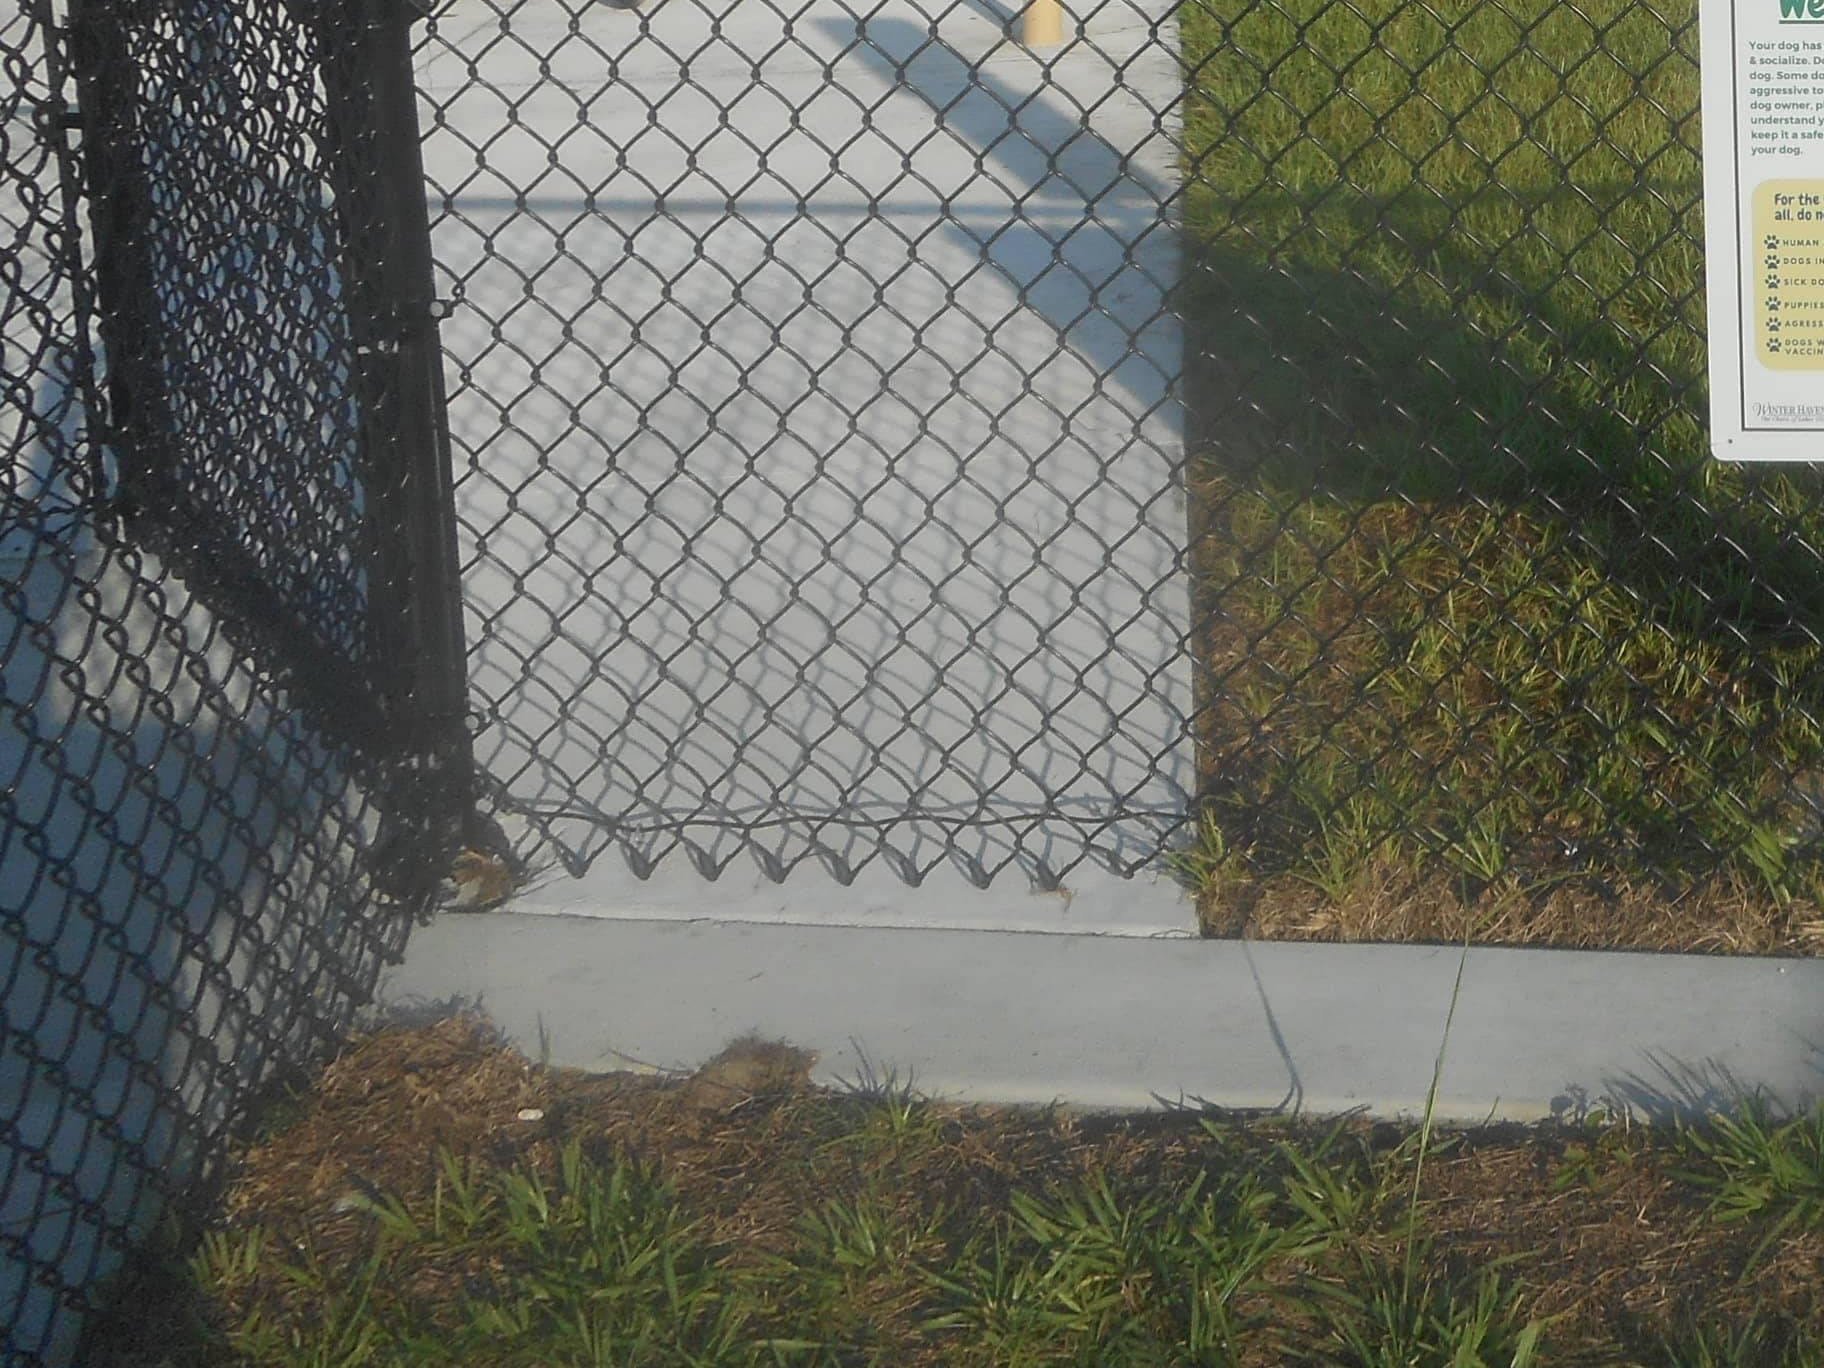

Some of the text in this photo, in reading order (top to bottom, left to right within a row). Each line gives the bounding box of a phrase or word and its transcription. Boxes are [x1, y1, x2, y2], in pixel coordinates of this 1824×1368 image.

[1748, 41, 1775, 49] Your
[1778, 40, 1799, 52] dog
[1802, 40, 1822, 49] has
[1749, 56, 1756, 64] &
[1759, 55, 1810, 64] socialize.
[1749, 71, 1773, 81] dog.
[1776, 71, 1808, 79] Some
[1749, 85, 1809, 96] aggressive
[1750, 100, 1771, 111] dog
[1774, 102, 1813, 110] owner,
[1750, 115, 1815, 124] understand
[1751, 130, 1778, 141] keep
[1781, 129, 1788, 139] it
[1800, 130, 1823, 139] safe
[1751, 145, 1802, 156] your dog.
[1774, 193, 1794, 206] For
[1798, 193, 1819, 206] the
[1797, 208, 1811, 220] do
[1784, 301, 1824, 309] PUPPIES
[1784, 338, 1812, 346] DOGS
